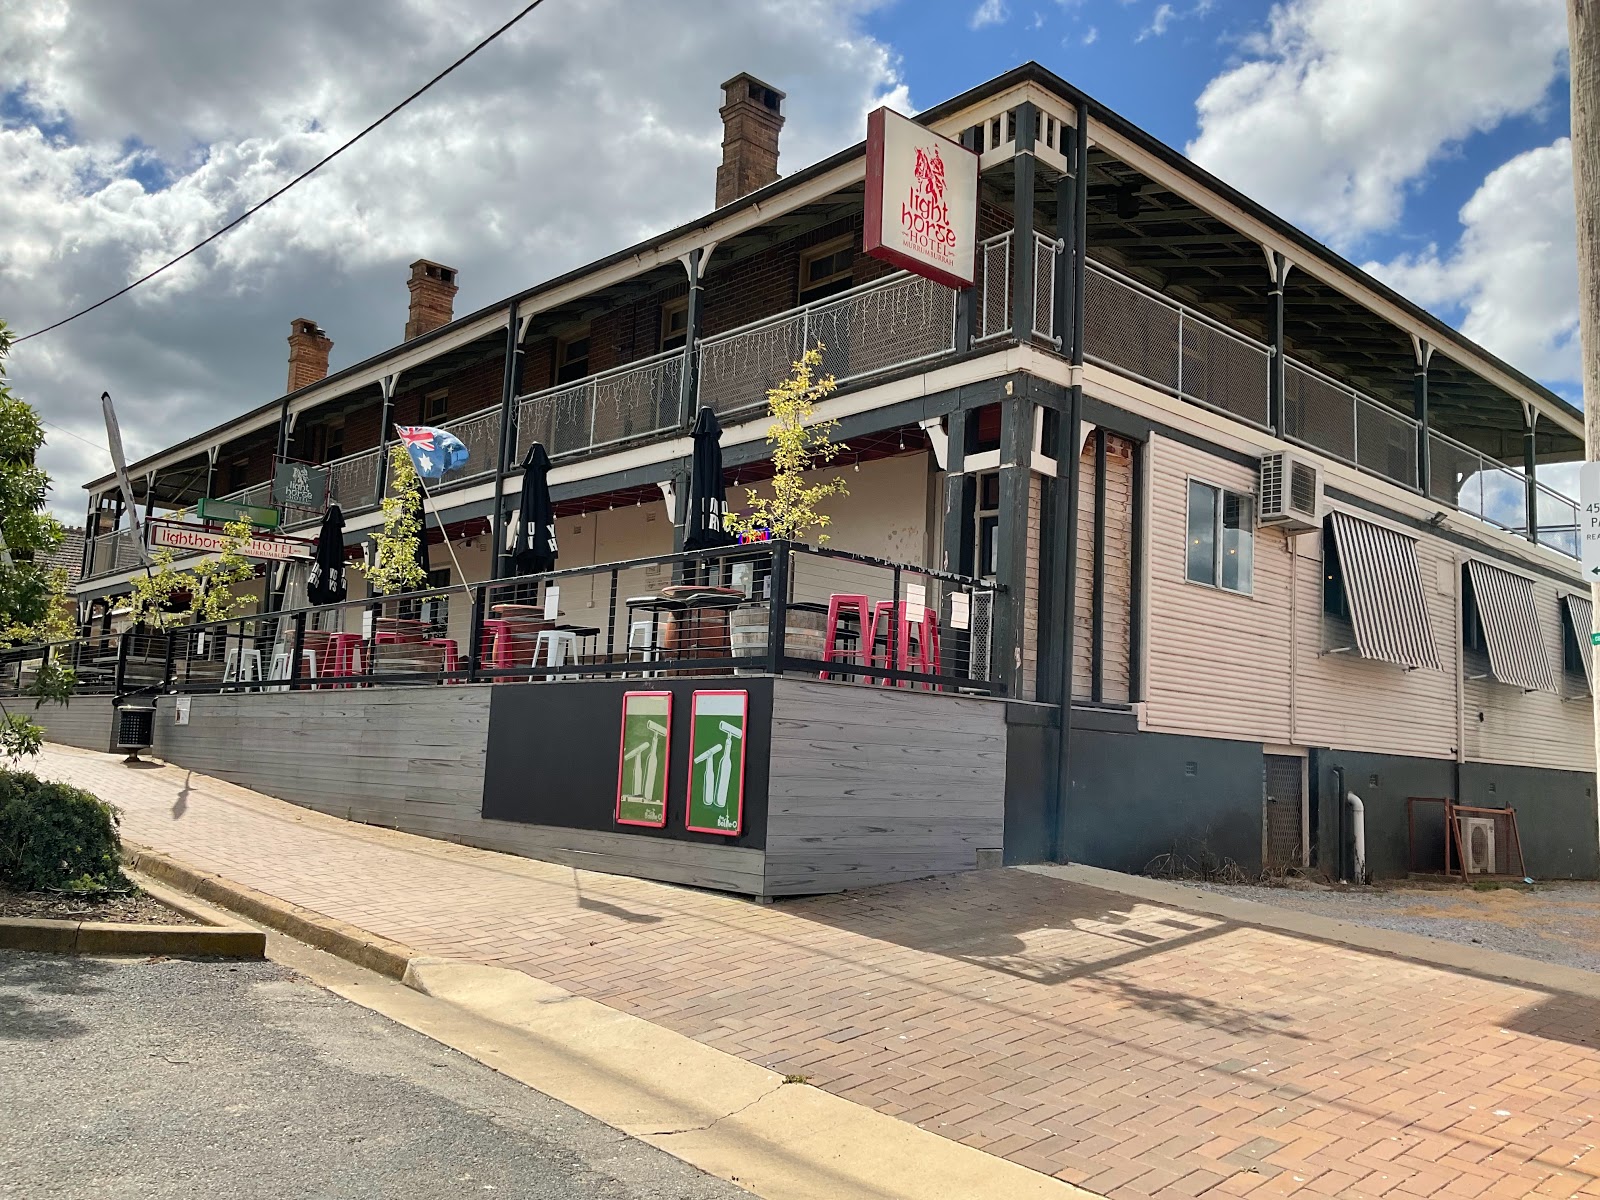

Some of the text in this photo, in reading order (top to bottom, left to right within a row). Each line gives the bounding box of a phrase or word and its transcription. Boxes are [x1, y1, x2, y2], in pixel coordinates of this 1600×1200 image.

[910, 186, 949, 226] light
[902, 202, 956, 247] horse
[903, 240, 954, 267] MURRUMBURRAH
[910, 230, 948, 257] HOTEL
[285, 486, 313, 499] horse
[289, 481, 310, 492] light
[252, 541, 295, 555] HOTEL
